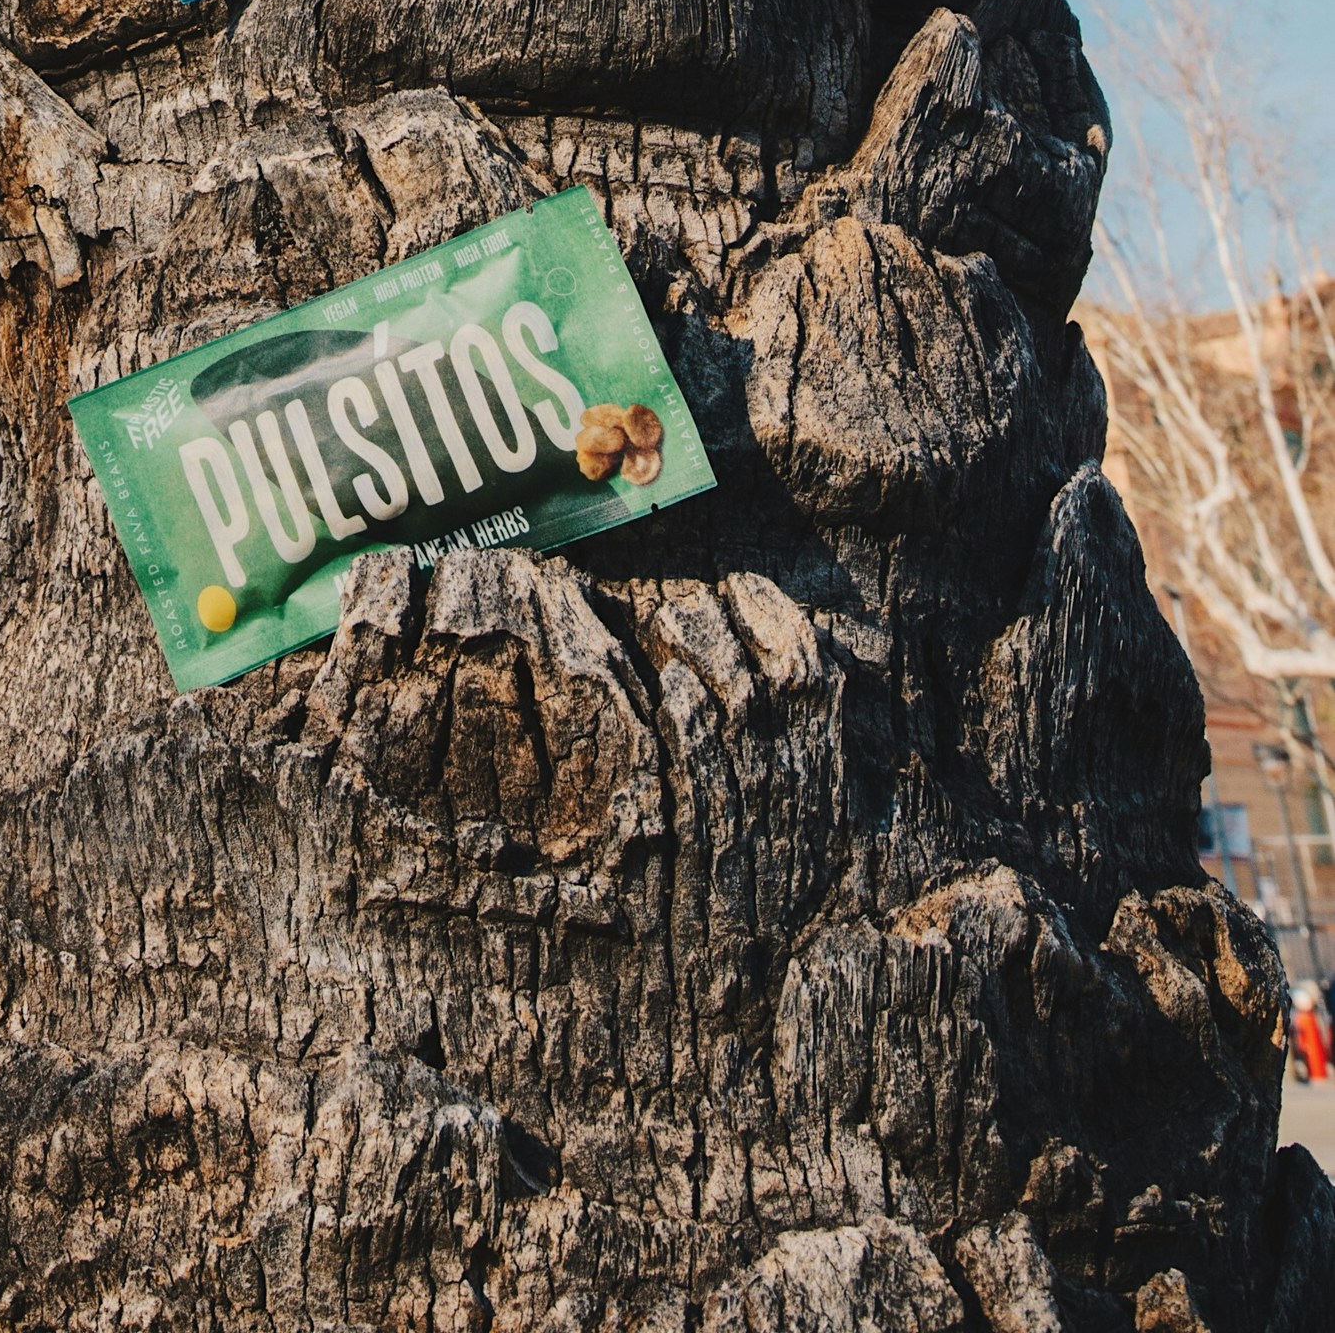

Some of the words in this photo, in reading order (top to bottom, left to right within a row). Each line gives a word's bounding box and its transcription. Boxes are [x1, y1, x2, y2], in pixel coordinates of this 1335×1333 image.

[453, 243, 482, 268] HIGH
[480, 229, 513, 258] FIBRE
[580, 206, 619, 274] PLANET
[372, 280, 401, 304] HIGH
[399, 261, 444, 292] PROTEIN
[617, 281, 628, 293] &
[321, 296, 358, 324] VEGAN
[624, 302, 660, 374] PEOPLE
[126, 384, 185, 450] FREE
[128, 377, 174, 424] PLASTIC
[657, 382, 702, 469] HEALTHY
[99, 440, 130, 499] BEANS
[178, 300, 587, 588] PULSÍTOS
[127, 507, 151, 555] FAVA
[471, 505, 530, 549] HERBS
[147, 564, 187, 650] ROASTED
